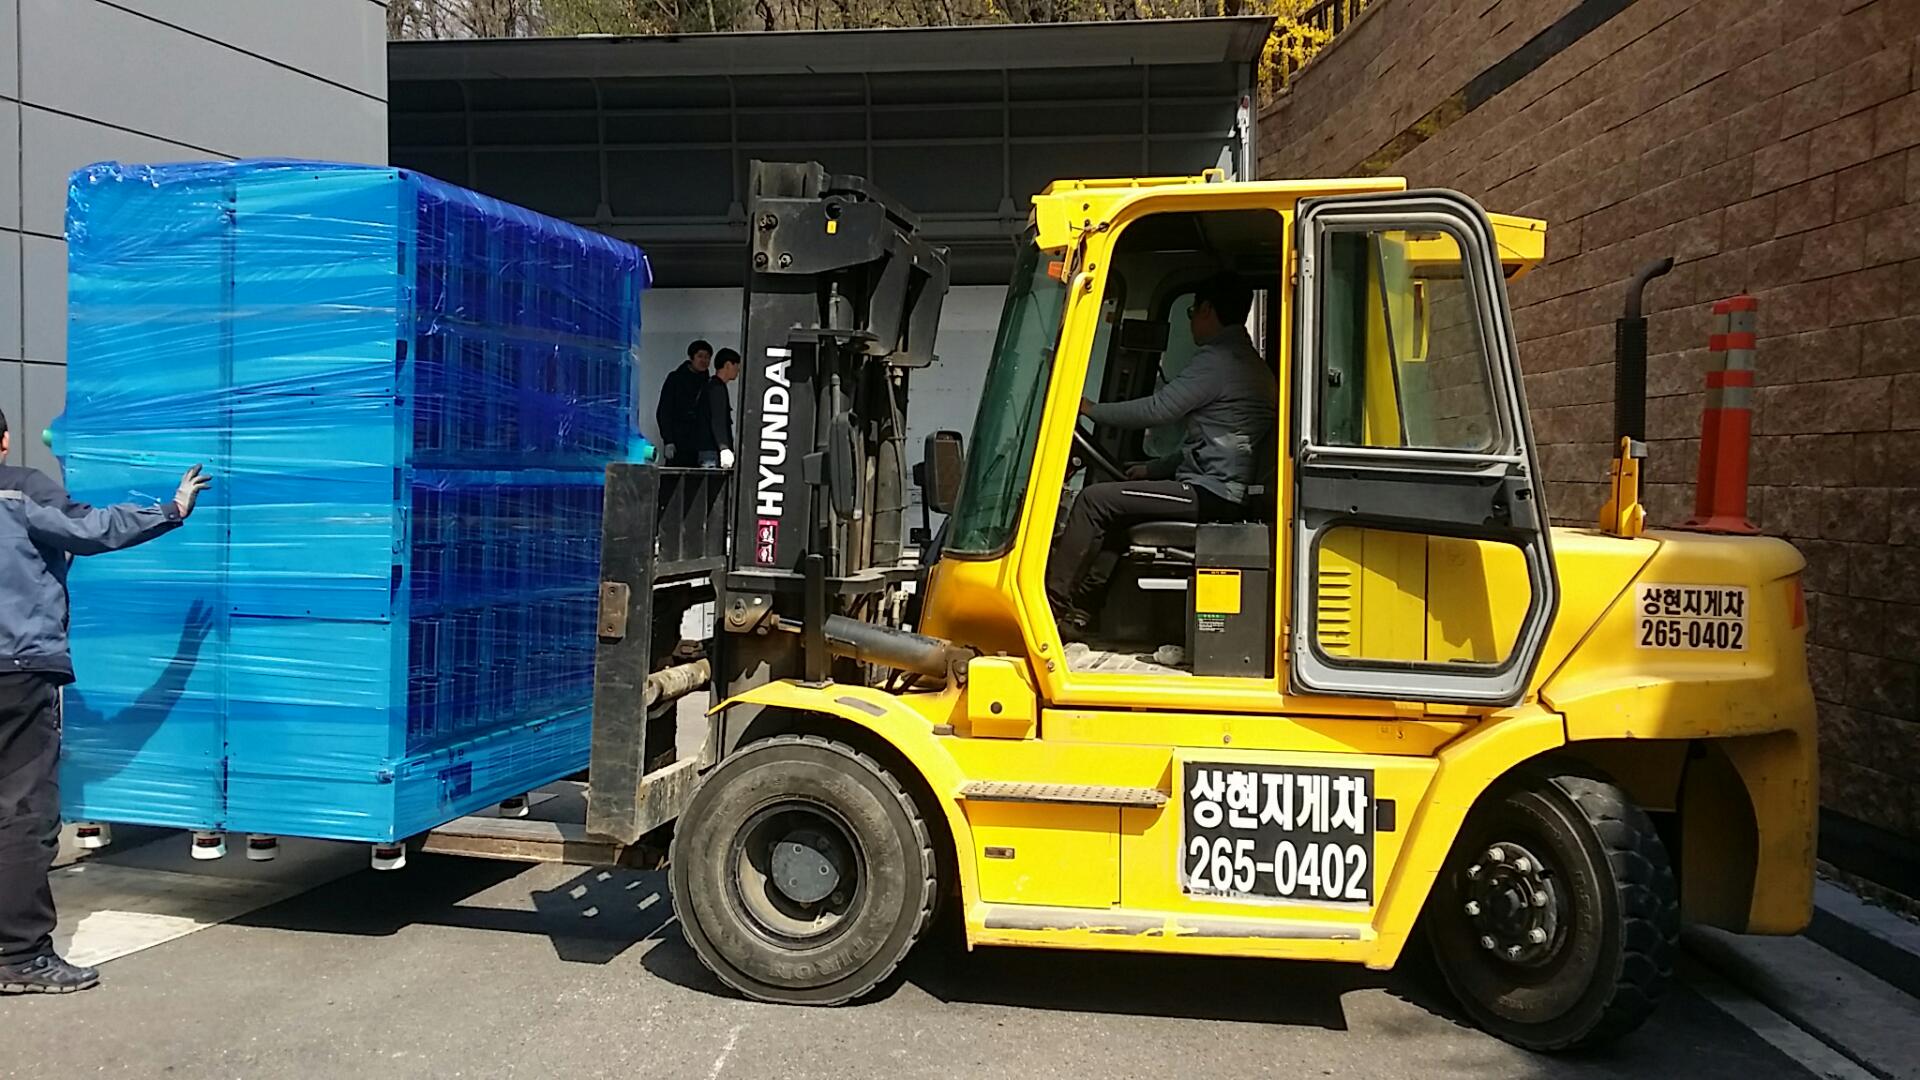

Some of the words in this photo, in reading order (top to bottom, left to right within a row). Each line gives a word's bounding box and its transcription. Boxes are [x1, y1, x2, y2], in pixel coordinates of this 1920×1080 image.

[756, 347, 792, 516] HYUNDAI
[1641, 619, 1743, 649] 265-0402
[1642, 588, 1744, 617] 상현지게차
[1190, 770, 1368, 834] 상현지게차
[1190, 836, 1367, 899] 265-0402
